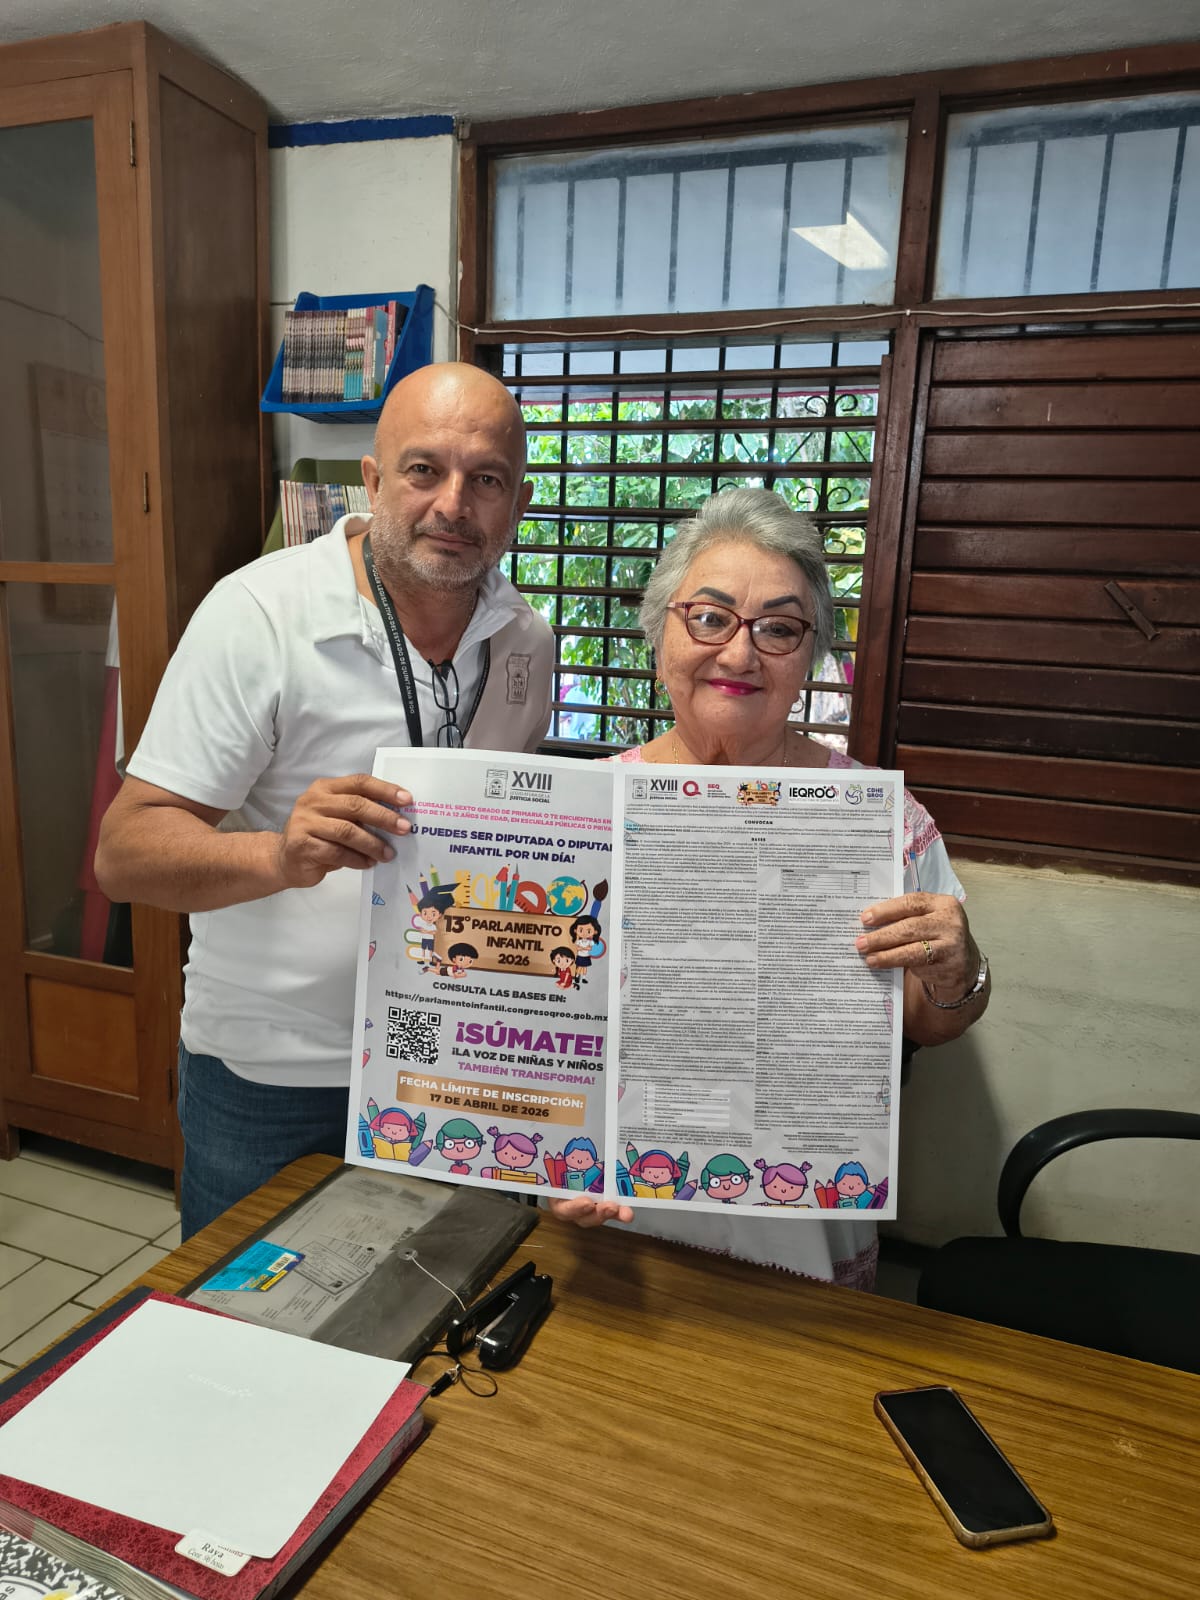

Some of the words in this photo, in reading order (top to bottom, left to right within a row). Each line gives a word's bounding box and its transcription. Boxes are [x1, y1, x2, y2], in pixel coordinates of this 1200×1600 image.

[377, 584, 393, 620] LEGISLATIVO
[393, 631, 403, 656] ESTADO
[400, 657, 406, 665] DE
[402, 665, 413, 699] QUINTANA
[511, 770, 552, 791] XVIII
[650, 778, 678, 791] XVIII
[418, 801, 444, 809] CURSAS
[511, 810, 542, 818] PRIMARIA
[559, 814, 601, 824] ENCUENTRAS
[460, 811, 479, 819] AÑOS
[490, 815, 510, 823] EDAD,
[520, 818, 554, 826] ESCUELAS
[554, 820, 586, 829] PÚBLICAS
[421, 826, 468, 839] PUEDES
[470, 831, 493, 841] SER
[495, 833, 554, 847] DIPUTADA
[556, 838, 566, 848] O
[449, 844, 503, 857] INFANTIL
[505, 849, 529, 860] POR
[532, 851, 549, 861] UN
[551, 852, 576, 864] DÍA!
[471, 919, 562, 937] PARLAMENTO
[486, 936, 544, 952] INFANTIL
[498, 953, 530, 966] 2026
[433, 981, 487, 995] CONSULTA
[489, 988, 510, 998] LAS
[512, 990, 547, 1002] BASES
[548, 994, 567, 1003] EN:
[385, 989, 608, 1022] https://parlamentoinfantil.congresoqroo.gob.mx
[455, 1020, 604, 1058] ¡SÚMATE!
[451, 1047, 470, 1057] ¡LA
[473, 1049, 497, 1061] VOZ
[499, 1053, 515, 1063] DE
[517, 1054, 554, 1067] NIÑAS
[556, 1059, 565, 1068] Y
[567, 1059, 604, 1072] NIÑOS
[458, 1061, 509, 1076] TAMBIÉN
[511, 1068, 596, 1085] TRANSFORMA!
[399, 1076, 438, 1091] FECHA
[441, 1081, 480, 1097] LÍMITE
[483, 1089, 499, 1099] DE
[502, 1090, 584, 1109] INSCRIPCIÓN:
[430, 1093, 442, 1102] 17
[444, 1095, 460, 1106] DE
[463, 1098, 499, 1112] ABRIL
[501, 1103, 518, 1114] DE
[521, 1105, 550, 1118] 2026
